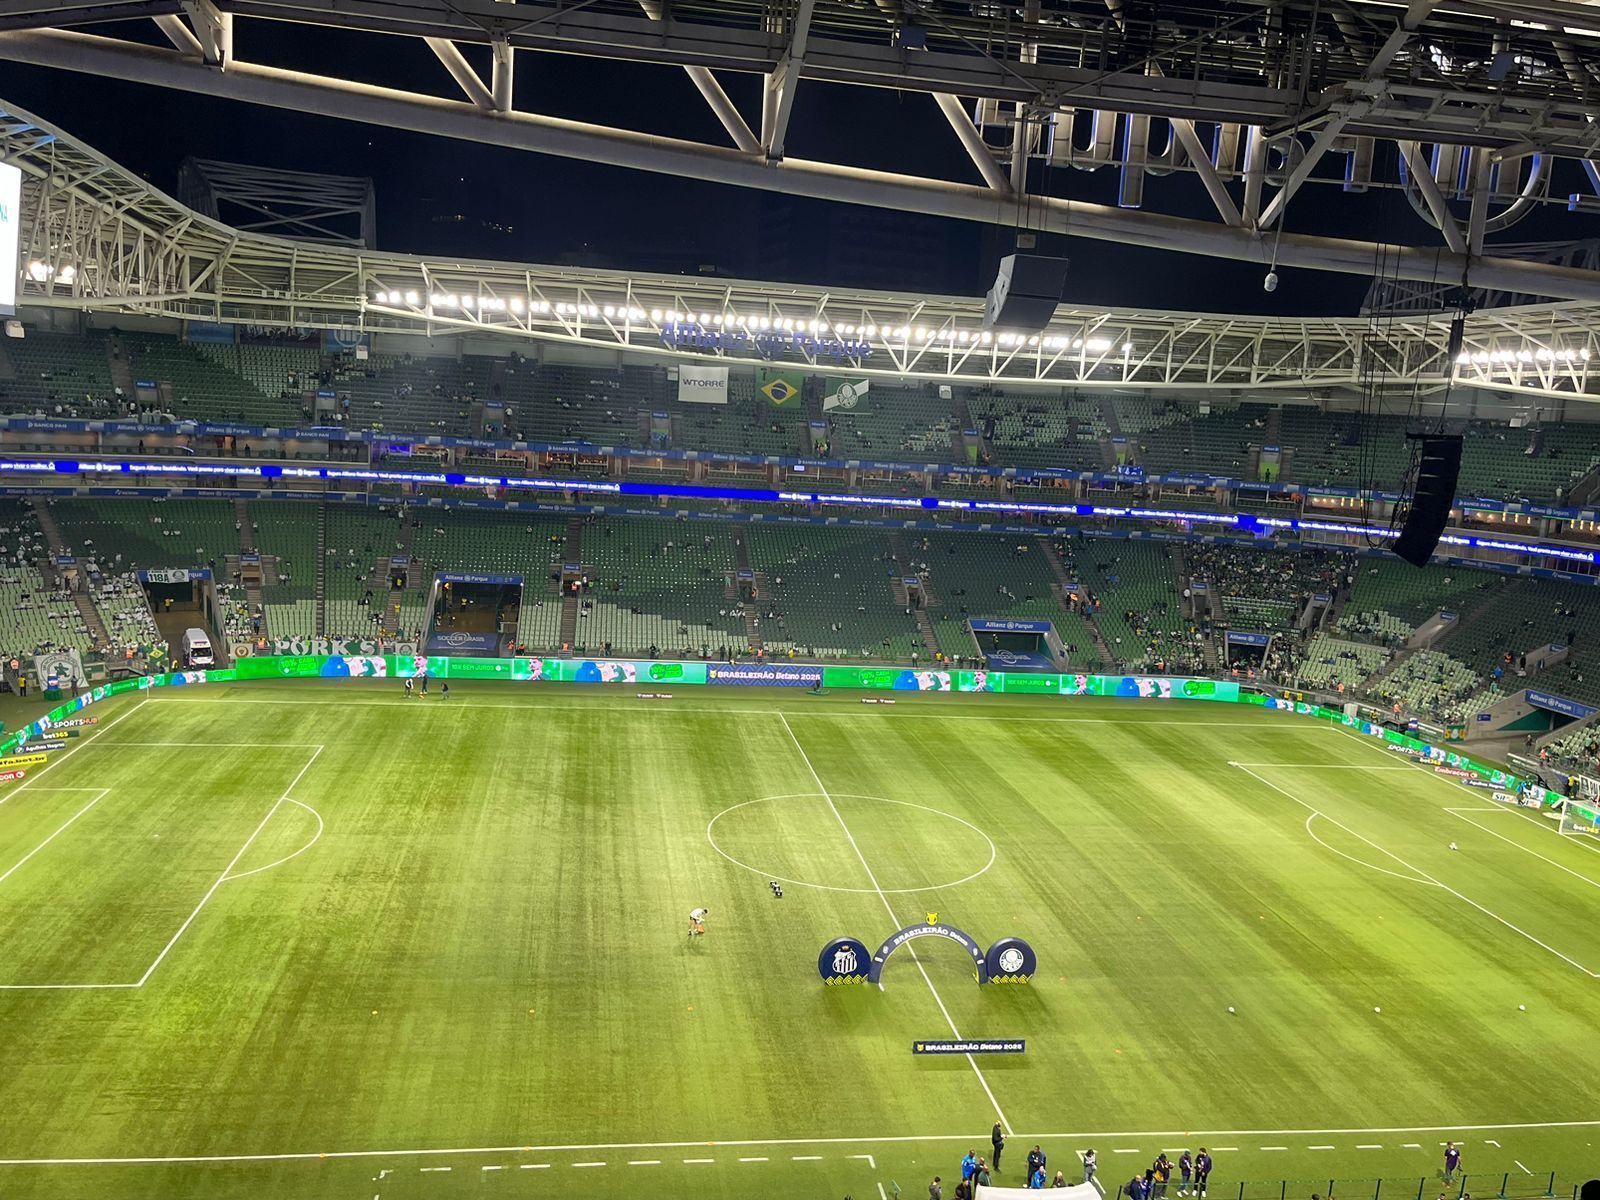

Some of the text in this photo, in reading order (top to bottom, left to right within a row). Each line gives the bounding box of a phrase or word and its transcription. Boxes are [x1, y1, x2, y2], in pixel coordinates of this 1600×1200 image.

[659, 323, 872, 363] Allianz Parque
[683, 378, 725, 388] WTORRE
[148, 573, 170, 583] 118A
[986, 621, 1006, 629] Allianz
[1228, 633, 1247, 641] Allianz
[717, 670, 775, 679] BRASILEIRÃO
[775, 672, 800, 680] Betano
[1529, 693, 1572, 710] Allianz Parque
[53, 716, 98, 729] SPORTSHUB
[42, 731, 69, 739] bet365
[1420, 757, 1441, 766] bet365
[1434, 766, 1469, 778] Embracon
[893, 926, 968, 947] BRASILEIRÃO Betano
[925, 1043, 979, 1051] BRASILEIRÃO
